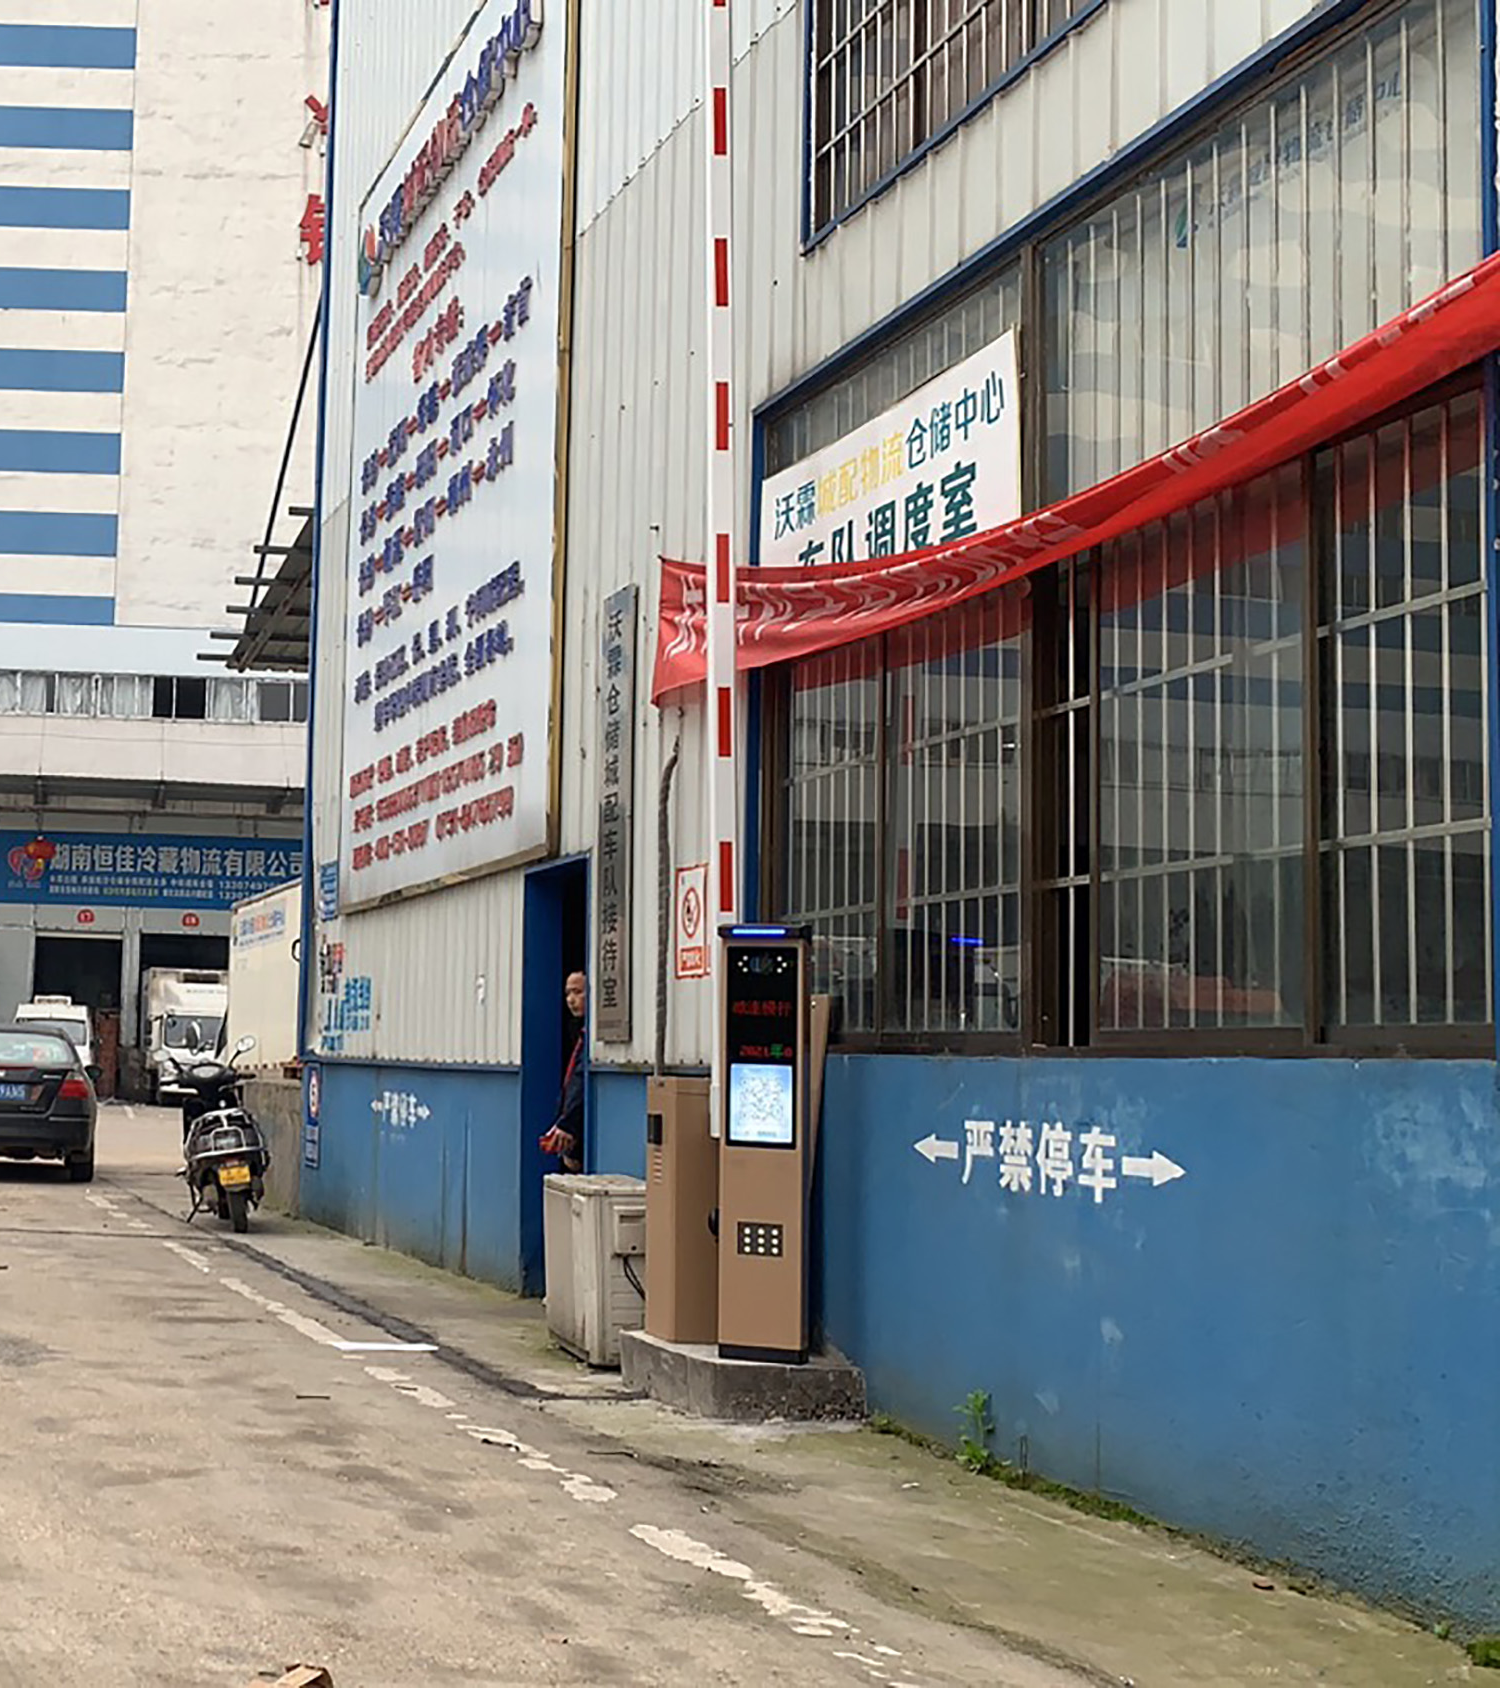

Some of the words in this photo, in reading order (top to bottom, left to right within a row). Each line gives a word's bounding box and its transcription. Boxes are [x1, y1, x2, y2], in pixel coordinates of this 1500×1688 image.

[774, 371, 1005, 540] 沃霖城配物流仓储中心
[50, 843, 302, 877] 湖南恒佳冷藏物流有限公司
[961, 1120, 1117, 1203] 严禁停车
